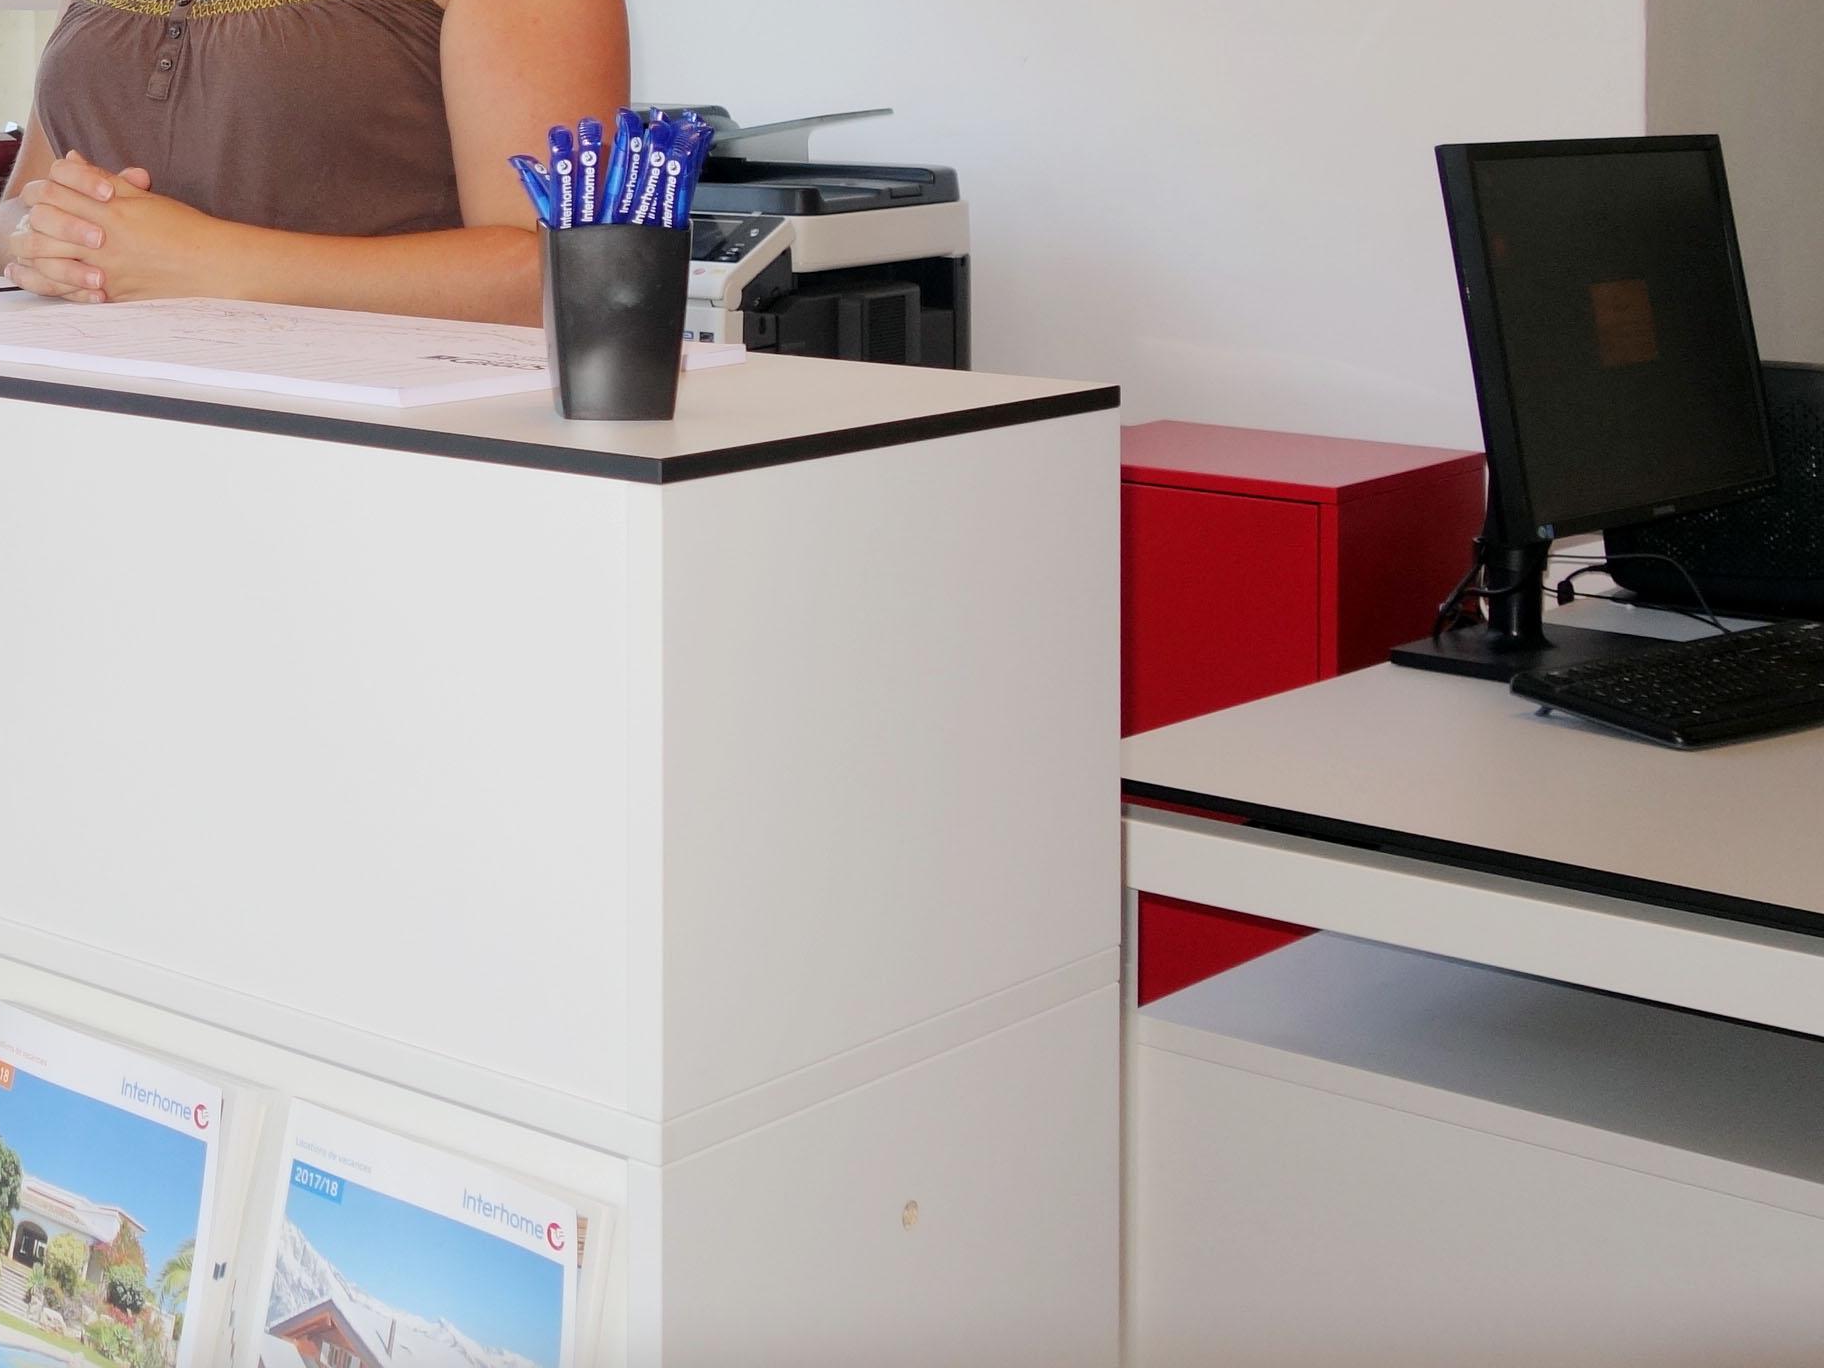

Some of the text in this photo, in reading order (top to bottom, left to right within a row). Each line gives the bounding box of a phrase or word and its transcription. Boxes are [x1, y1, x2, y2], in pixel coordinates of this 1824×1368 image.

[560, 175, 572, 229] Interhome
[581, 167, 595, 222] Interhome
[619, 153, 641, 214] Interhome
[632, 167, 660, 225] Interhome
[663, 175, 677, 228] nterhome
[121, 1076, 192, 1121] Interhome
[295, 1165, 339, 1198] 2017/18
[462, 1187, 544, 1241] Interhome
